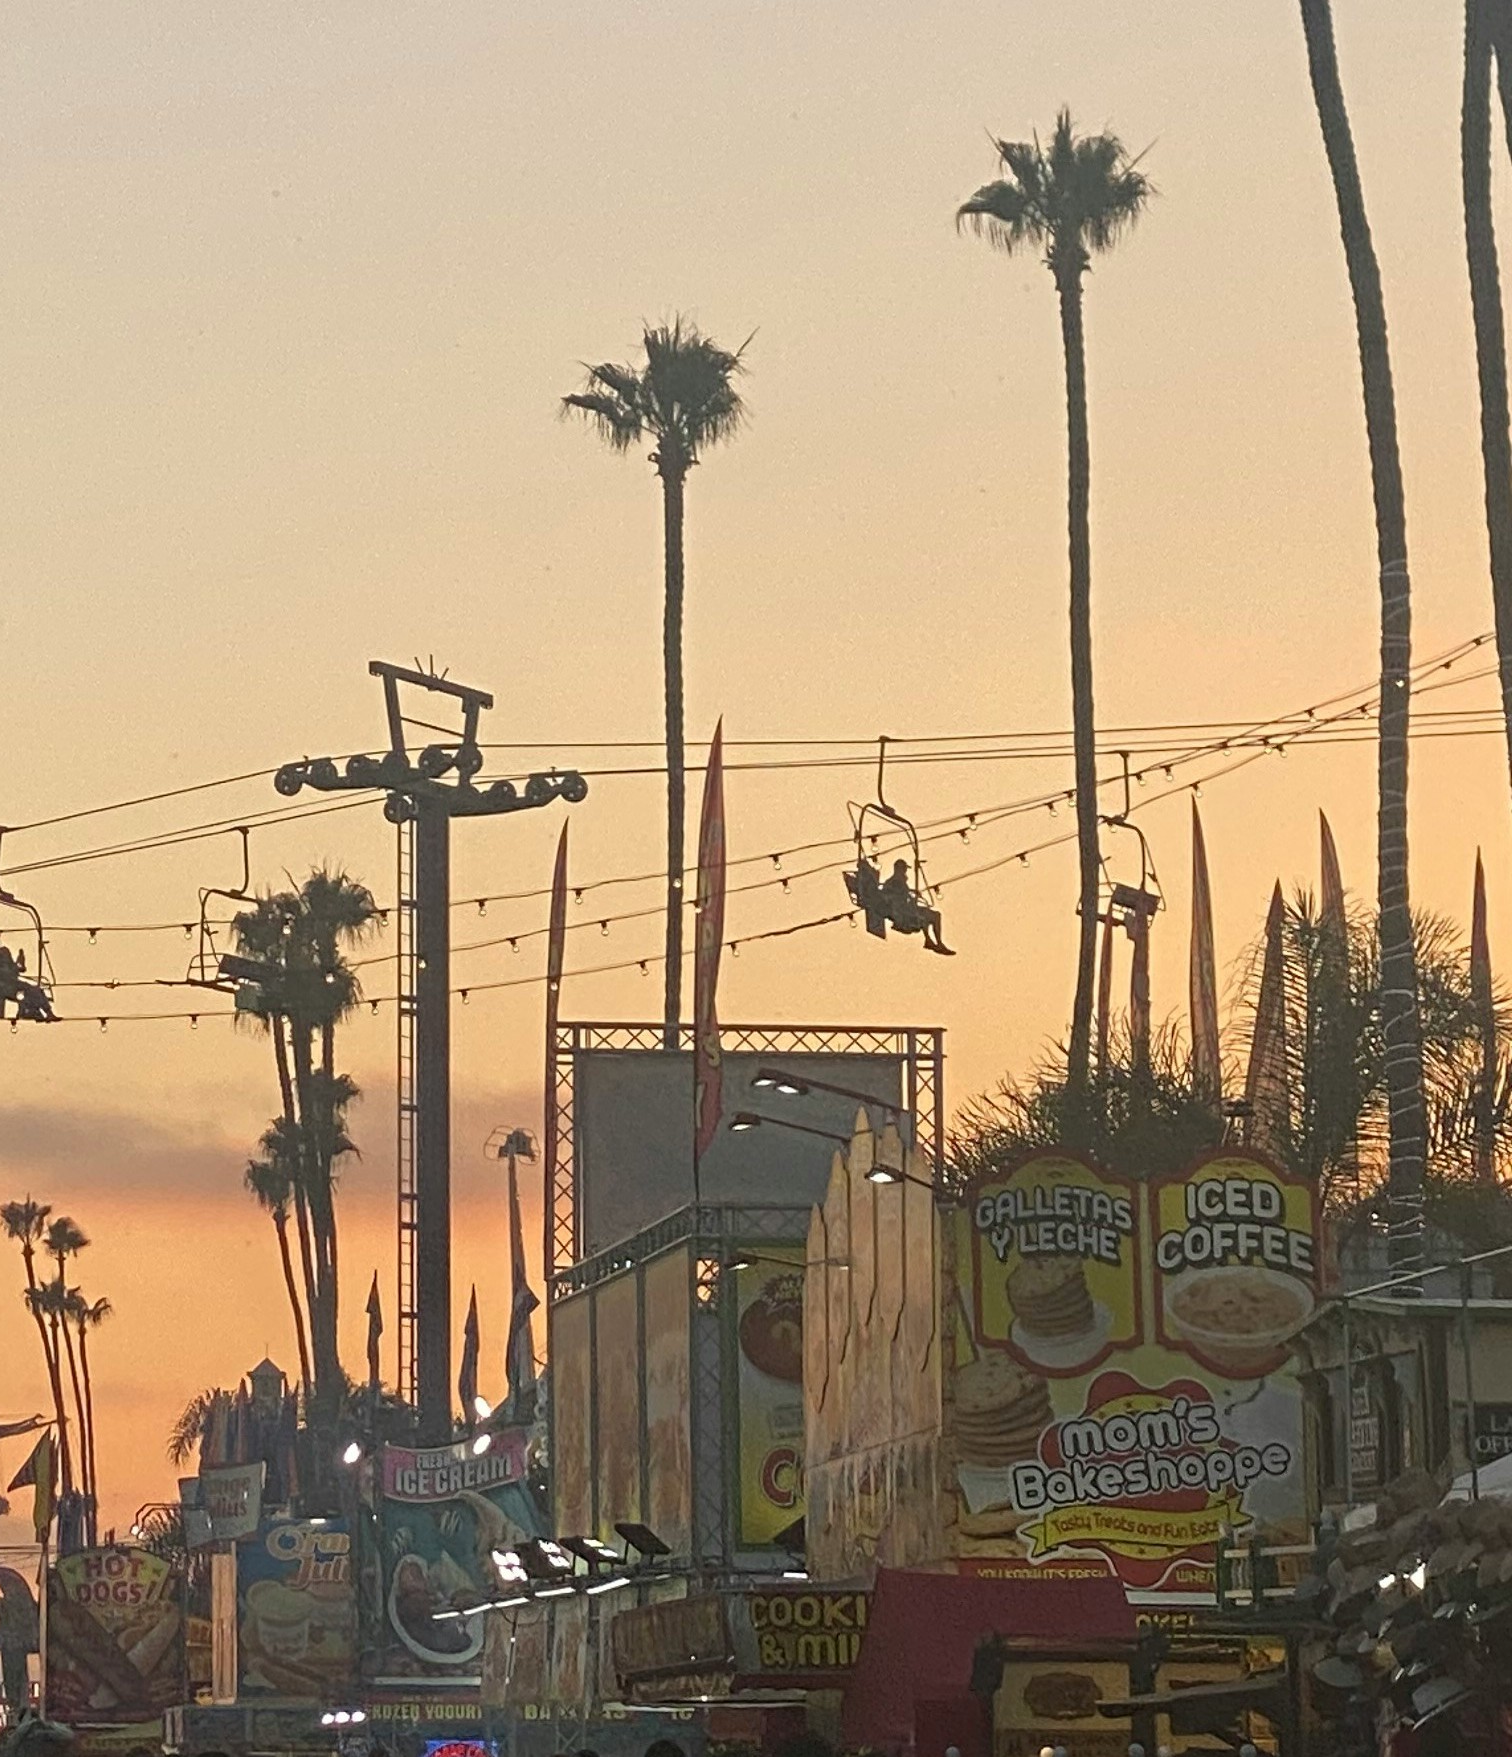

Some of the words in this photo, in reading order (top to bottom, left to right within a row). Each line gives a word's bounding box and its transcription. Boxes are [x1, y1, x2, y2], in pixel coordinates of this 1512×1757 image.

[975, 1185, 1133, 1234] GALLETAS
[1186, 1179, 1282, 1221] ICED
[991, 1226, 1013, 1261] Y
[1018, 1221, 1121, 1263] LECHE
[1157, 1223, 1315, 1274] COFFEE
[395, 1467, 430, 1495] ICE
[434, 1454, 512, 1495] CREAM
[416, 1453, 451, 1469] FRESH
[760, 1446, 805, 1508] C
[1013, 1442, 1291, 1510] Bakeshoppe
[1051, 1517, 1092, 1536] Tasty
[1093, 1512, 1135, 1534] Treats
[1137, 1518, 1161, 1535] and
[1164, 1520, 1188, 1539] Fun
[84, 1553, 145, 1578] HOT
[76, 1579, 157, 1605] DOGS!
[761, 1633, 786, 1666] &
[368, 1703, 420, 1721] ROZEN
